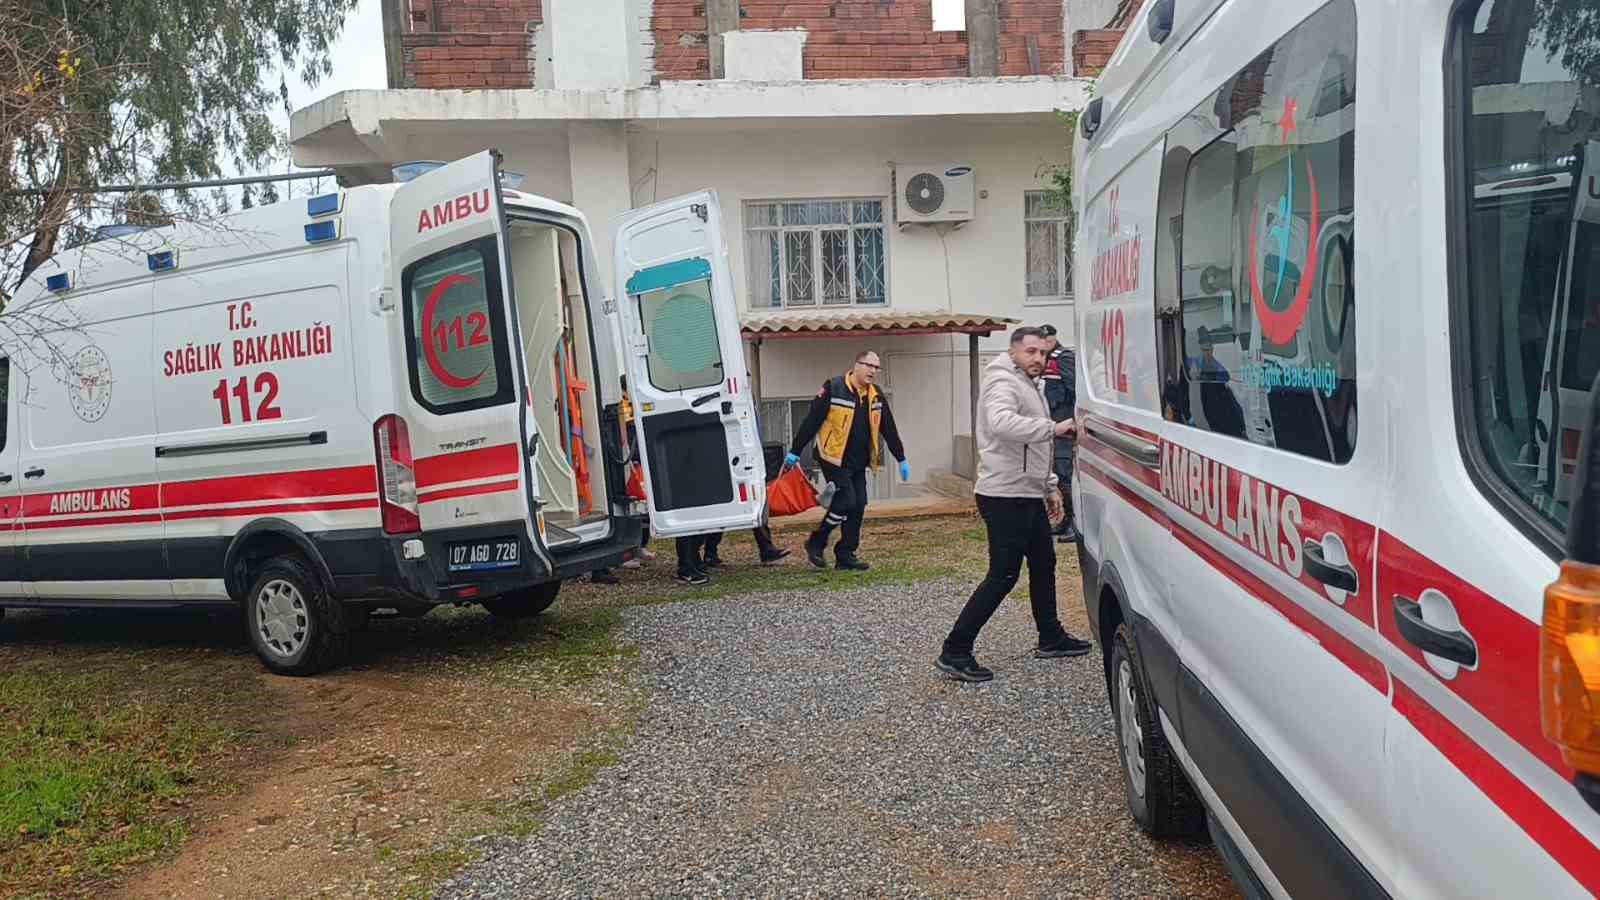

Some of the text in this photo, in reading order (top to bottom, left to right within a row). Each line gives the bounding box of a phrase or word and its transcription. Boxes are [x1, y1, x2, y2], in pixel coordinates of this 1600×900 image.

[418, 189, 491, 233] AMBU
[226, 301, 257, 331] T.C.
[434, 311, 492, 354] 112
[163, 320, 333, 377] SAĞLIK BAKANLIĞI
[1101, 307, 1128, 393] 112
[212, 371, 283, 425] 112
[1283, 361, 1336, 398] Bakanlığı
[49, 488, 131, 514] AMBULANS
[1160, 441, 1304, 578] AMBULANS
[453, 546, 467, 563] 07
[496, 542, 517, 561] 728
